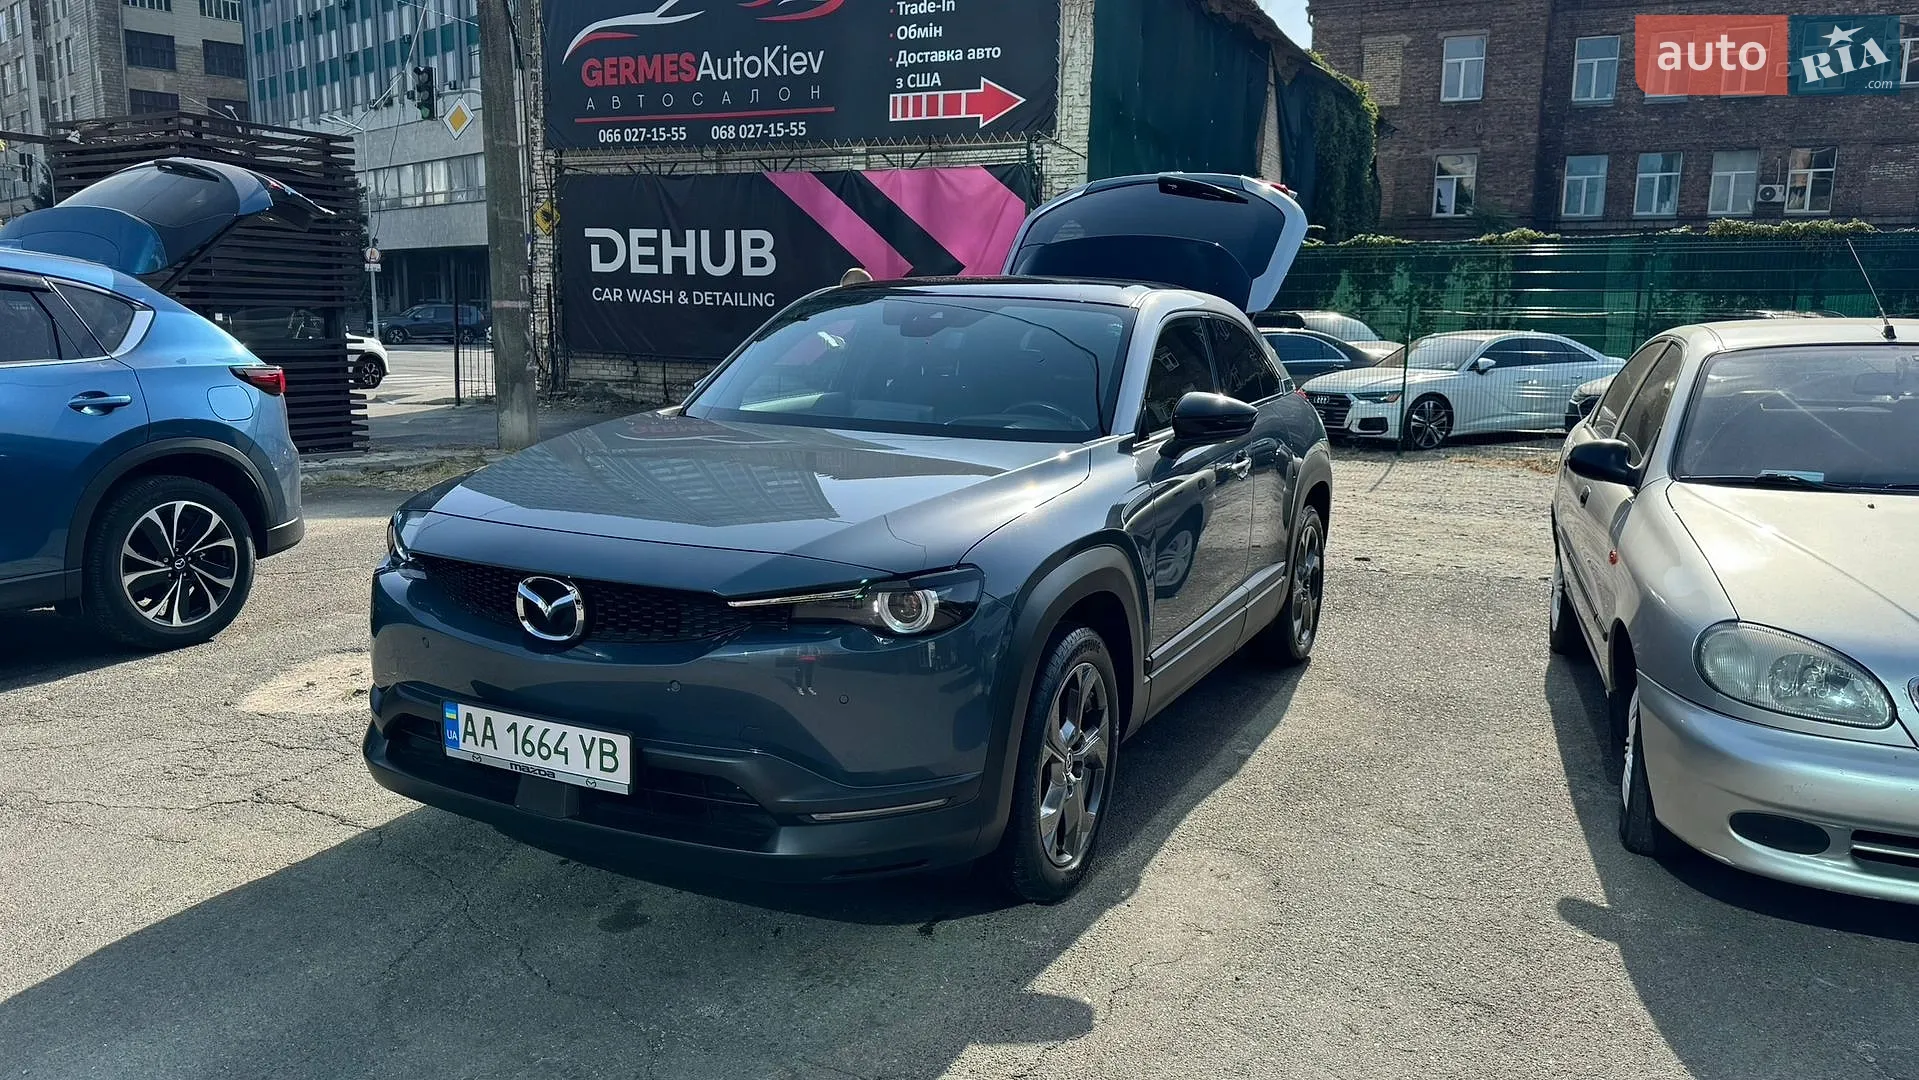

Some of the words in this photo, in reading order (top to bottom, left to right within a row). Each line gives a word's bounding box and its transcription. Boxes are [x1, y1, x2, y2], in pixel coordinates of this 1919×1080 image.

[896, 0, 956, 16] Trade-In
[896, 22, 943, 40] Обмін
[895, 48, 963, 68] Доставка
[967, 46, 1002, 60] авто
[895, 77, 904, 89] з
[907, 72, 942, 88] США
[586, 85, 821, 111] АВТОСАЛОН
[598, 128, 622, 143] 066
[623, 126, 687, 142] 027-15-55
[711, 125, 736, 140] 068
[739, 121, 807, 139] 027-15-55
[584, 227, 777, 277] DEHUB
[592, 287, 623, 302] CAR
[626, 288, 674, 305] WASH
[677, 290, 689, 305] &
[693, 290, 776, 308] DETAILING
[446, 729, 458, 741] UA
[462, 712, 498, 751] AA
[506, 722, 569, 766] 1664
[578, 733, 620, 774] YB
[509, 761, 556, 779] mazda
